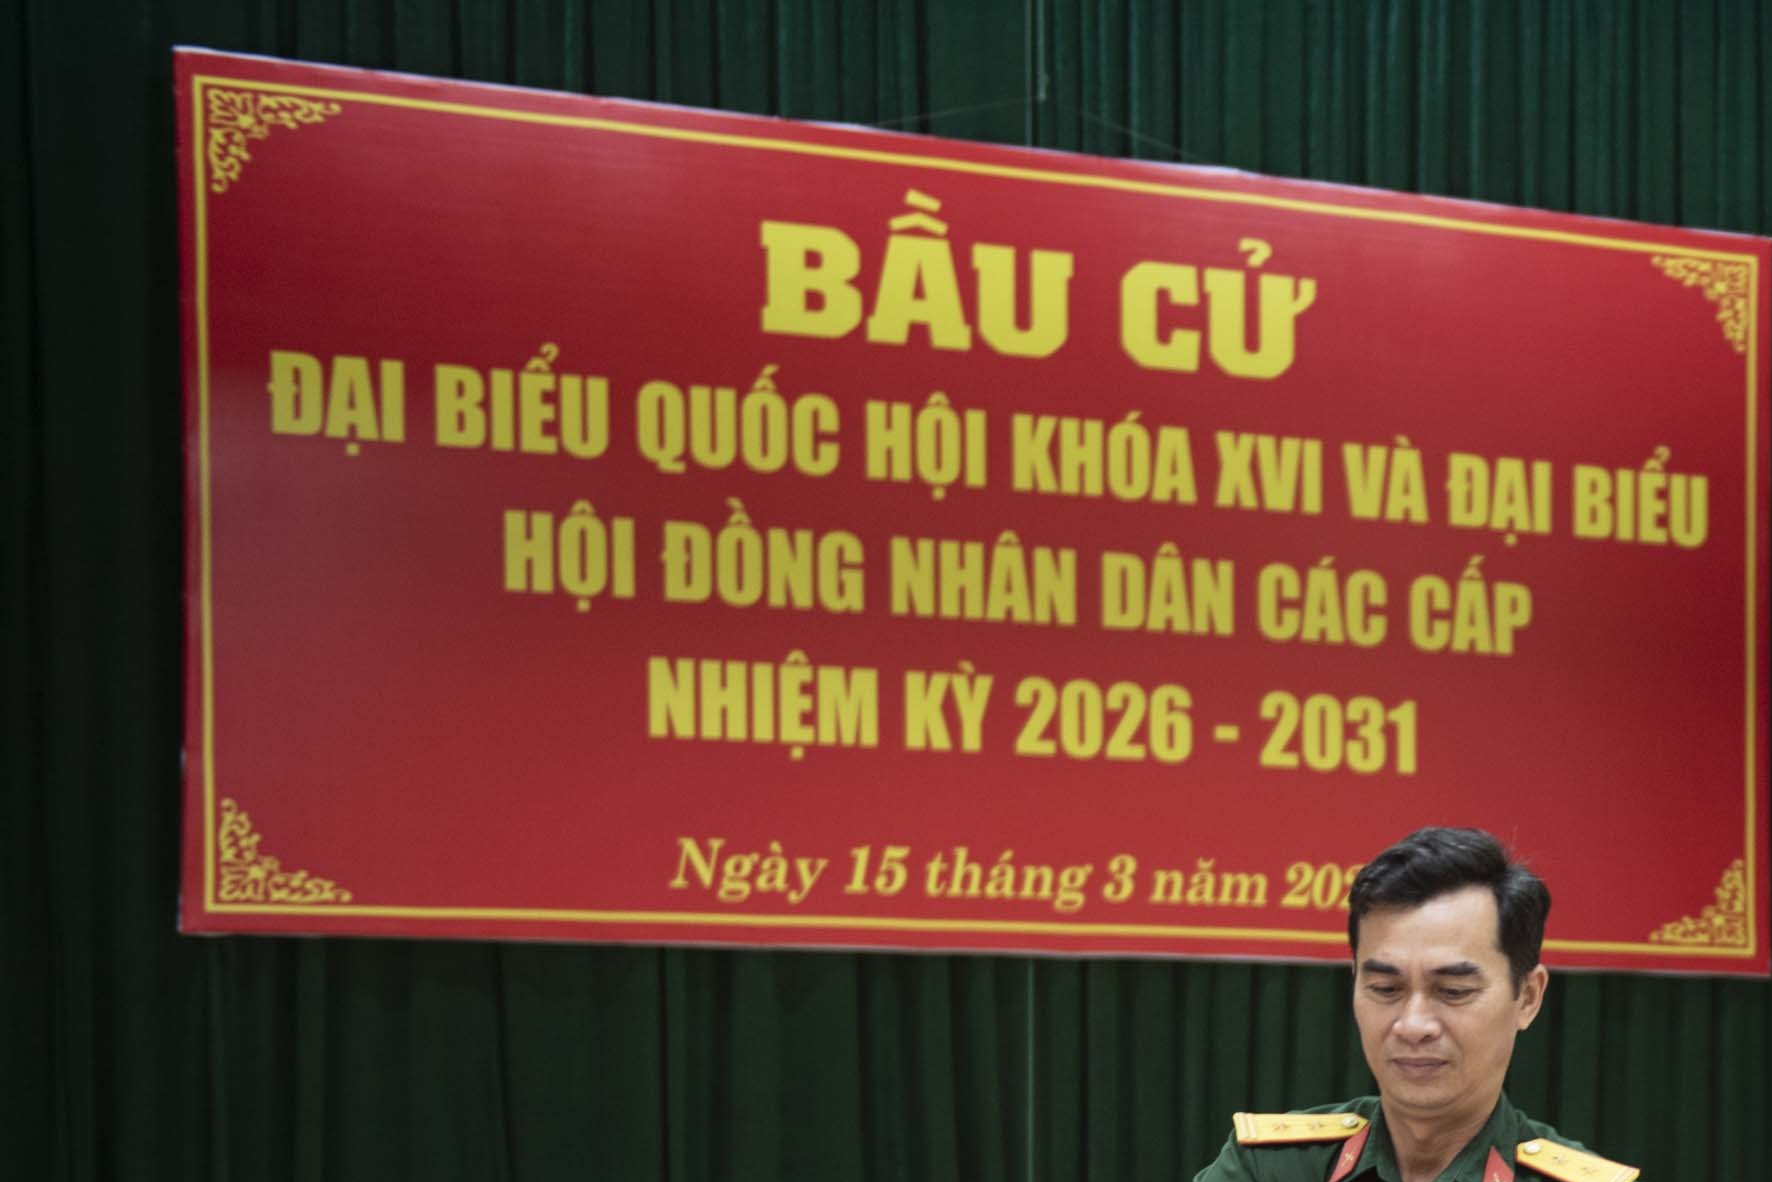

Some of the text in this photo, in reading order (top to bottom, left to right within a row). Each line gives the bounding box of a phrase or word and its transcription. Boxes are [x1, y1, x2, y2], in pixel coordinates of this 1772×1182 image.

[760, 189, 1316, 379] BẦU CỬ
[268, 342, 1707, 547] ĐẠI BIỂU QUỐC HỘI KHÓA XVI VÀ ĐẠI BIỂU
[505, 498, 1531, 655] HỘI ĐỒNG NHÂN DÂN CÁC CẤP
[648, 651, 1416, 774] NHIỆM KỲ 2026 - 2031
[669, 838, 826, 902] Ngày
[847, 846, 908, 894] 15
[926, 847, 1092, 911] tháng
[1104, 855, 1136, 901] 3
[1151, 860, 1267, 906] năm
